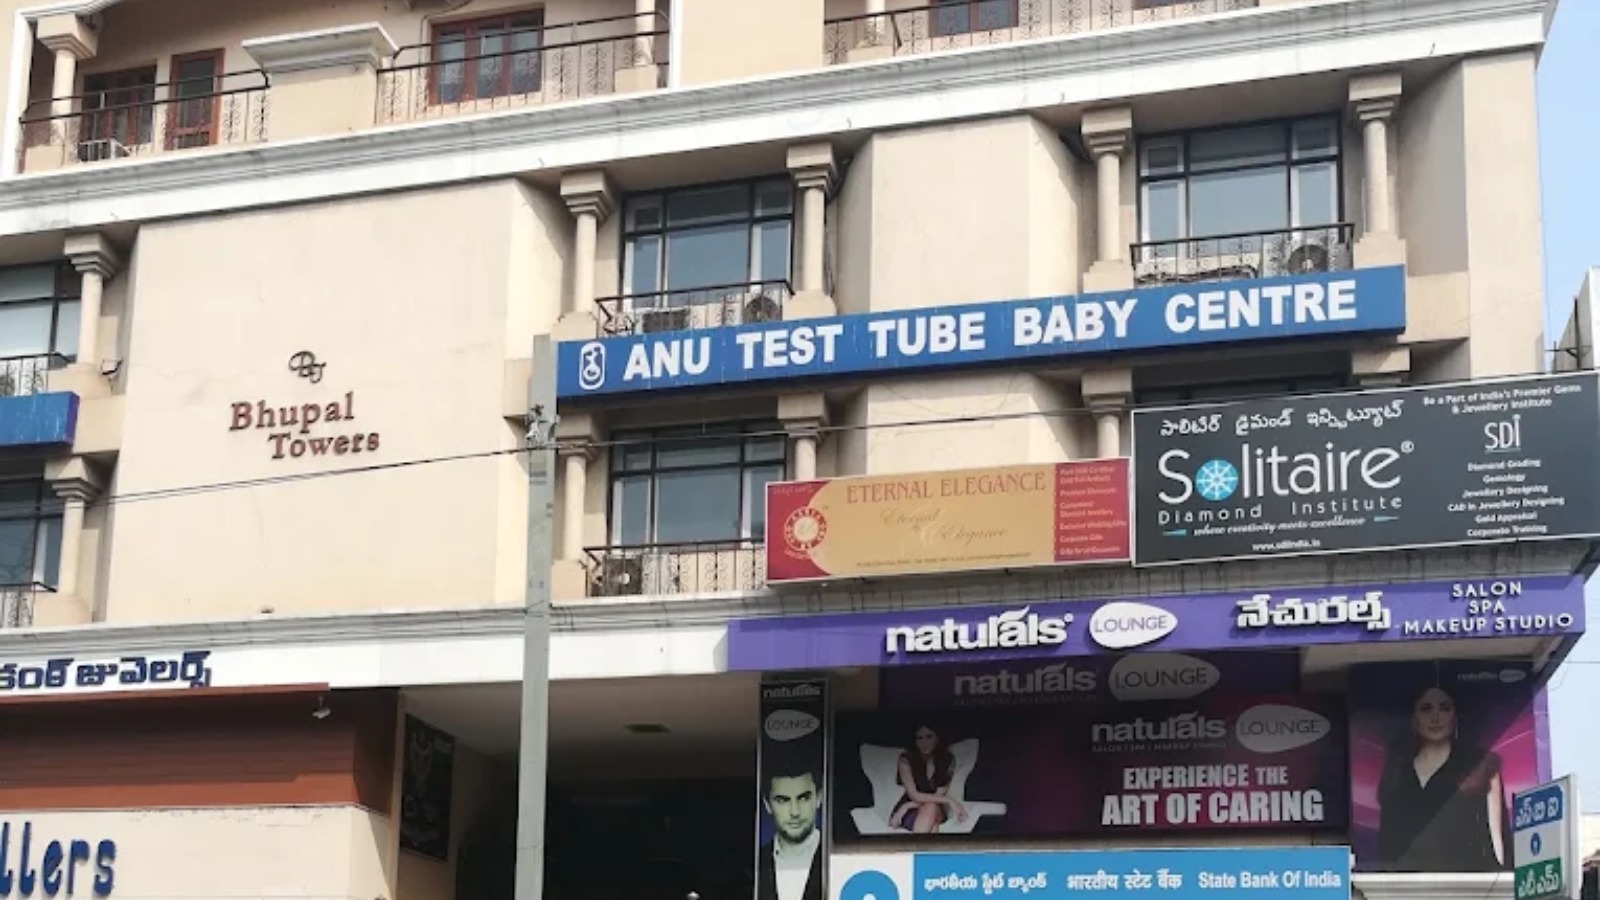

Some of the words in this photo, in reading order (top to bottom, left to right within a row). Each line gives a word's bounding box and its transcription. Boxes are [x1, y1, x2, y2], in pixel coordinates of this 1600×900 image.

[623, 336, 711, 380] ANU
[736, 324, 843, 369] TEST
[868, 312, 986, 357] TUBE
[1013, 298, 1138, 346] BABY
[1165, 279, 1357, 333] CENTRE
[1446, 394, 1466, 404] Part
[1513, 386, 1552, 397] Premier
[1462, 402, 1508, 413] Jewellery
[1511, 397, 1552, 409] Institute
[229, 391, 354, 434] Bhupal
[268, 431, 380, 460] Towers
[846, 480, 934, 504] ETERNAL
[940, 472, 1047, 498] ELEGANCE
[1462, 487, 1504, 498] Jewellery
[1157, 504, 1262, 525] Diamond
[1291, 495, 1402, 515] Institute
[1478, 499, 1521, 510] Jewellery
[1227, 523, 1276, 534] creativity
[1467, 527, 1511, 537] Corporate
[1451, 581, 1522, 598] SALON
[1236, 591, 1391, 630] నేచురల్స్
[1468, 599, 1506, 615] SPA
[886, 605, 1068, 653] naturals
[1093, 613, 1169, 631] LOUNGE
[1404, 617, 1488, 634] MAKEUP
[1495, 612, 1574, 631] STUDIO
[954, 662, 1097, 695] naturals
[1114, 667, 1207, 689] LOUNGE
[1092, 711, 1226, 742] naturals
[1240, 719, 1321, 736] LOUNGE
[1123, 763, 1249, 790] EXPERIENCE
[1255, 766, 1288, 786] THE
[1101, 794, 1159, 825] ART
[1166, 792, 1202, 824] OF
[1208, 789, 1324, 824] CARING
[1066, 869, 1118, 890] भारतीय
[1123, 868, 1152, 890] स्टेट
[1157, 868, 1182, 890] बैंक
[1198, 870, 1236, 889] State
[1240, 869, 1279, 888] Bank
[1283, 870, 1301, 888] Of
[1305, 869, 1341, 888] India
